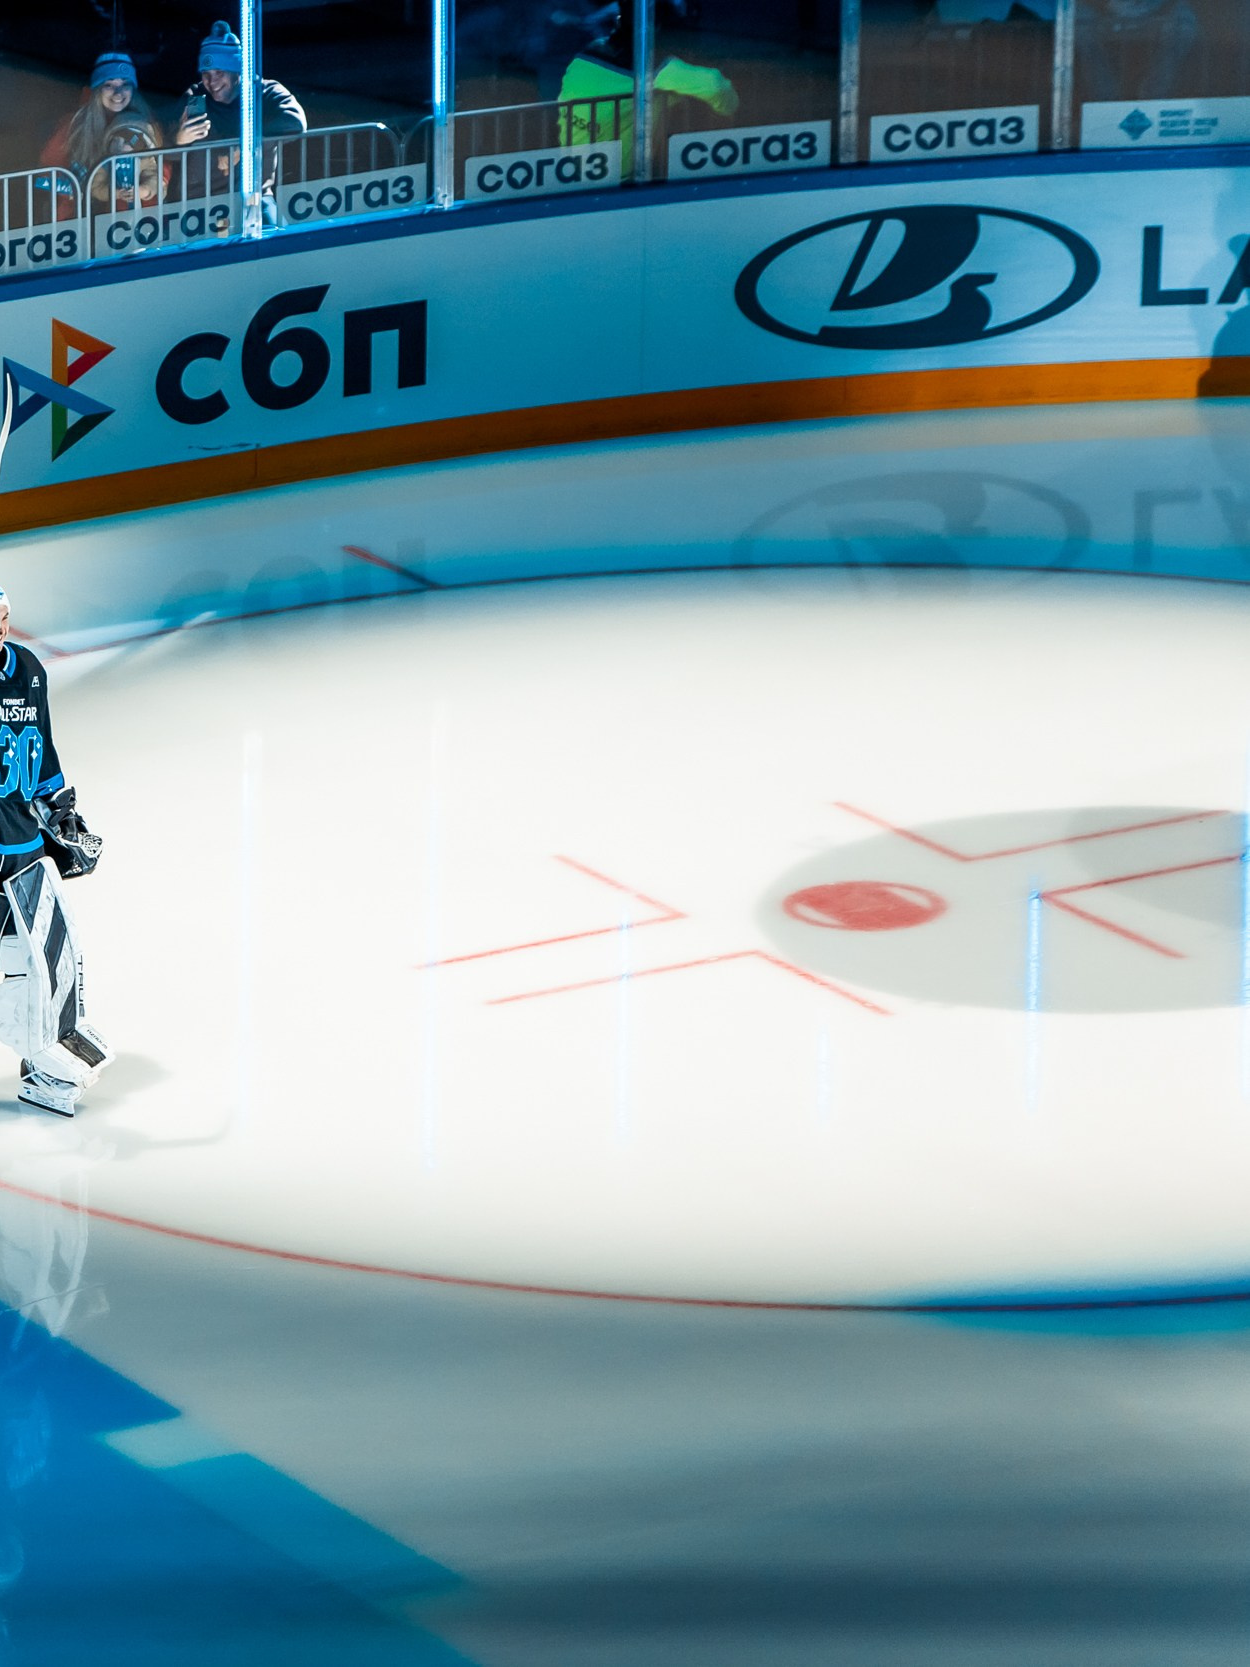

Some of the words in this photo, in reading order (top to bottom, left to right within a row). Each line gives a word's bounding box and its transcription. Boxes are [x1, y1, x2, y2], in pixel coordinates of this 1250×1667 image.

[680, 131, 817, 171] согаз
[883, 115, 1025, 153] согаз
[477, 152, 608, 193] согаз
[288, 175, 415, 220] согаз
[107, 204, 230, 250] согаз
